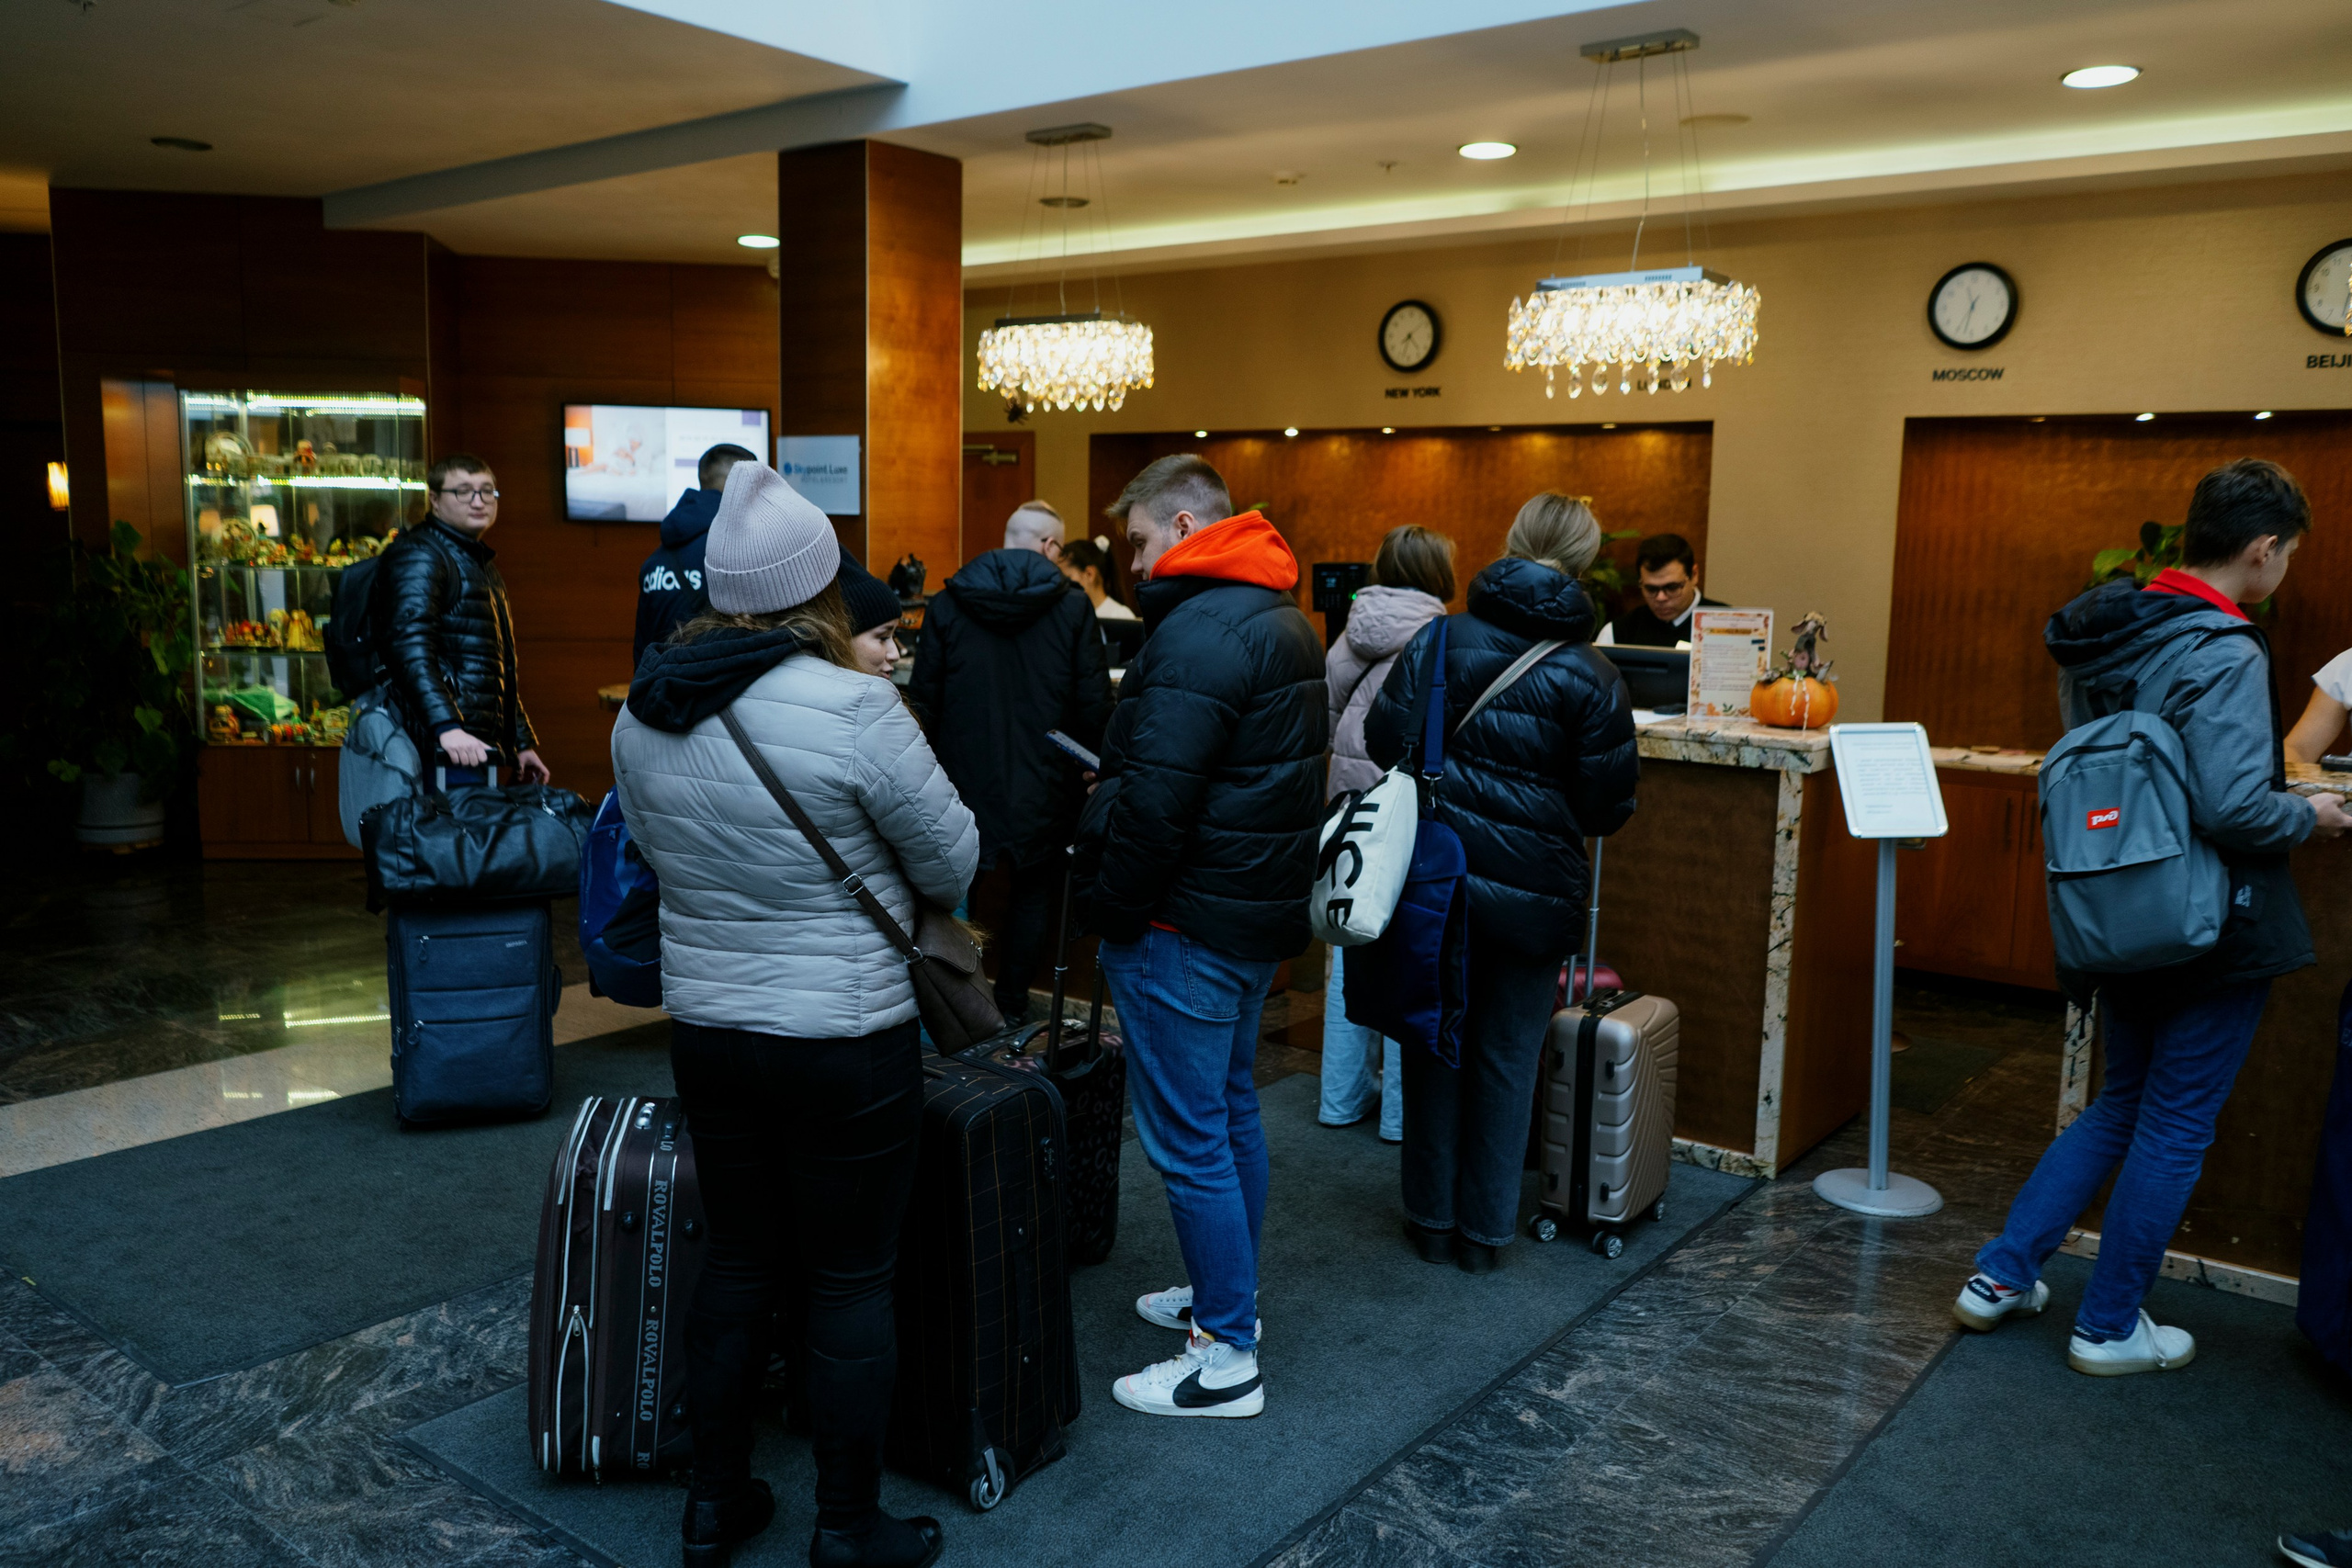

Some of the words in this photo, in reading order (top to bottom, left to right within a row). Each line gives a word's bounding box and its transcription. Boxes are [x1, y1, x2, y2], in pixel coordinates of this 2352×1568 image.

[1932, 368, 2005, 382] MOSCOW
[1385, 388, 1409, 399] NEW
[1411, 386, 1441, 398] YORK
